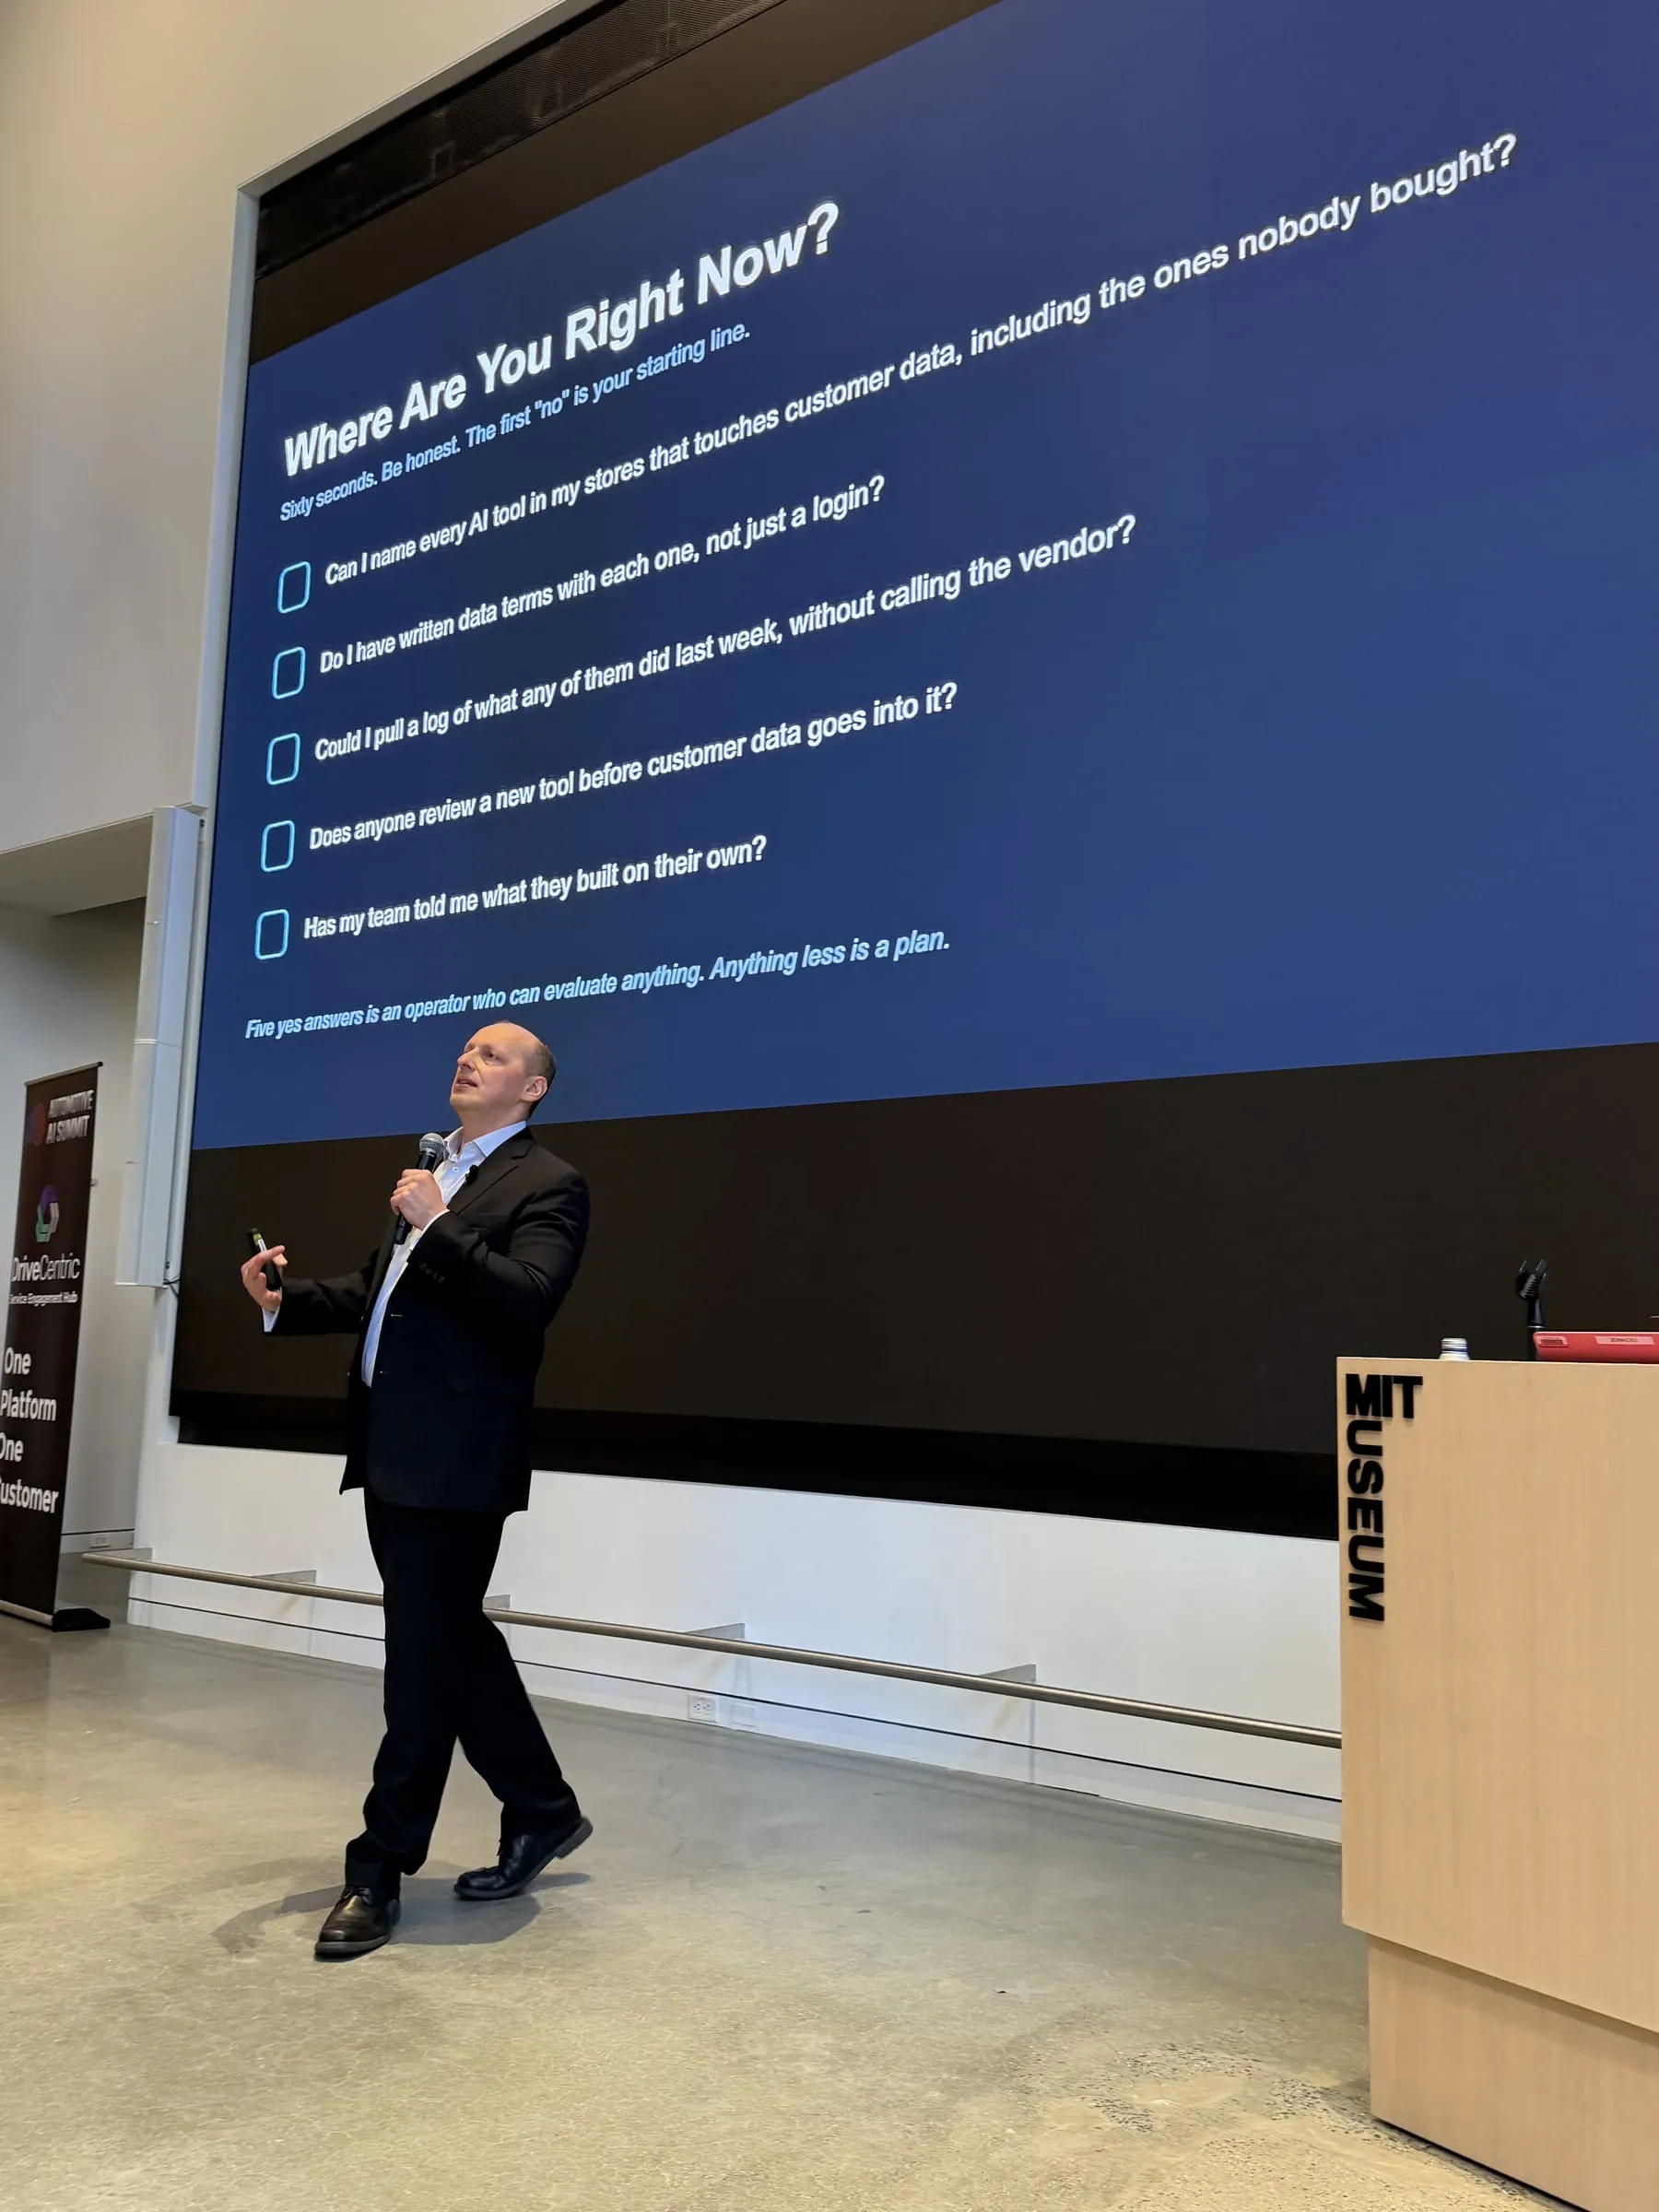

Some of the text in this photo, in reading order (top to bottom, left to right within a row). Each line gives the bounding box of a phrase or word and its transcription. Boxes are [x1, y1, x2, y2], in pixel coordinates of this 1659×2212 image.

[284, 200, 840, 477] Where Are You Right Now?
[325, 133, 1516, 584] Can I name every AI tool in my stores that touches customer data, including the ones nobody bought?
[280, 324, 749, 521] Sixty seconds. Be honest. The first "no" is your starting line.
[321, 474, 885, 673] Do I have written data terms with each one, not just a login?
[315, 513, 1136, 760] Could I pull a log of what any of them did last week, without calling the vendor?
[310, 682, 957, 849] Does anyone review a new tool before customer data goes into it?
[304, 835, 766, 938] Has my team told me what they built on their own?
[245, 930, 949, 1039] Five yes answers is an operator who can evaluate anything. Anything less is a plan.
[56, 1115, 90, 1142] SUMMIT
[11, 1253, 80, 1282] DriveCentric
[0, 1389, 57, 1421] Platform
[4, 1347, 31, 1375] One
[1346, 1373, 1423, 1419] MIT
[0, 1476, 59, 1513] ustomer
